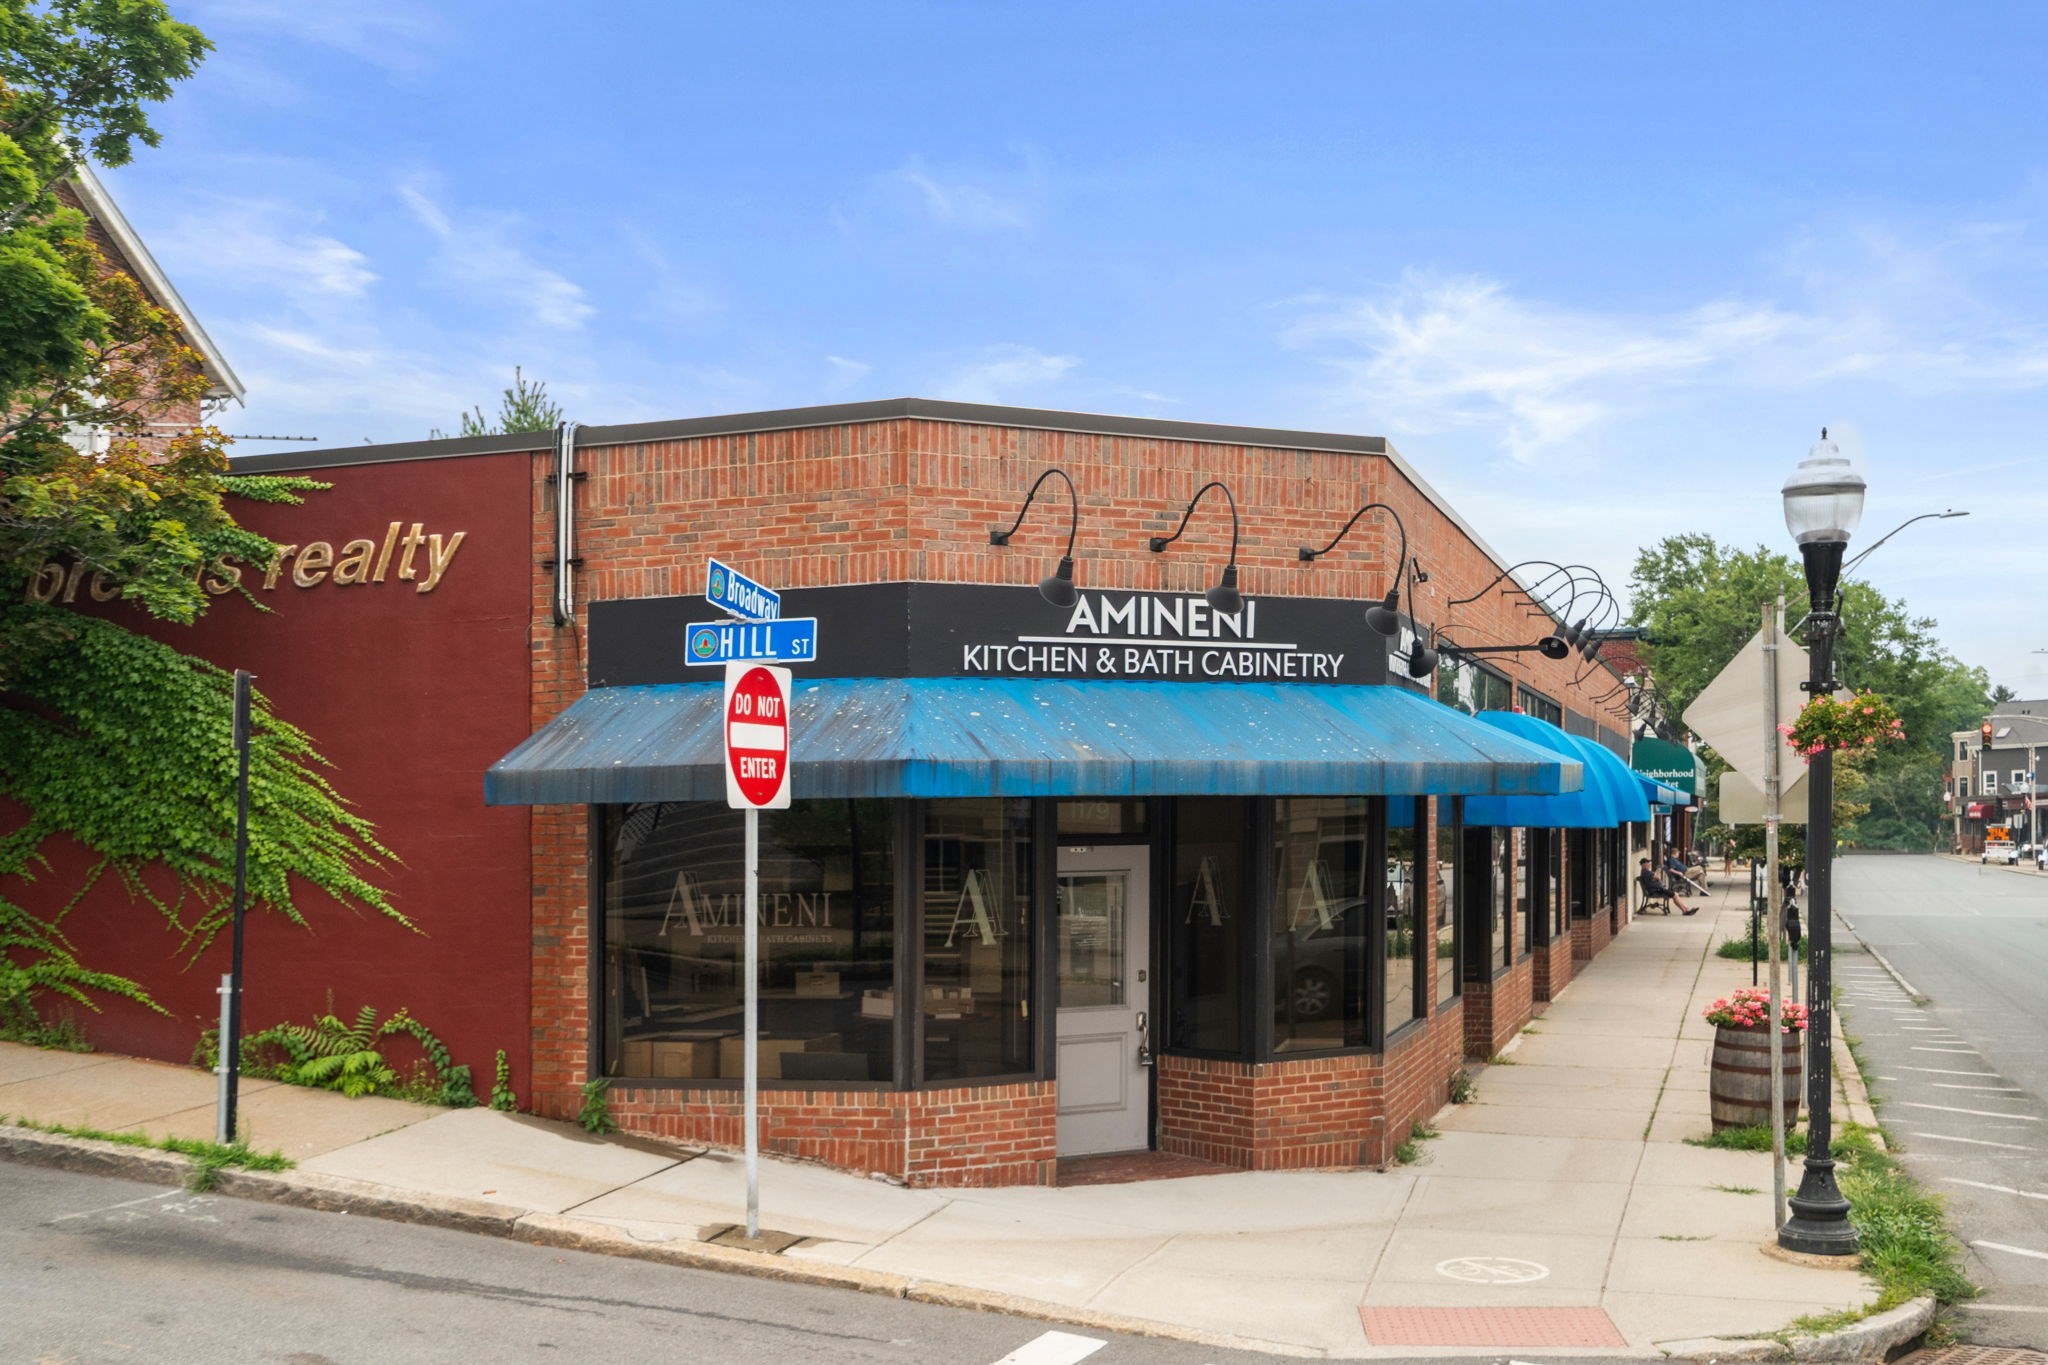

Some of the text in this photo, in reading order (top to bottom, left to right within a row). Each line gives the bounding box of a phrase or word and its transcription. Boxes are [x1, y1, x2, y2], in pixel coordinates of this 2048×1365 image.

[25, 521, 468, 604] bres realty
[727, 571, 778, 620] Broadway
[1065, 594, 1256, 639] AMINENI
[720, 626, 810, 658] HILL ST
[963, 644, 1345, 678] KITCHEN & BATH CABINETRY
[735, 693, 780, 718] DO NOT
[740, 756, 777, 779] ENTER
